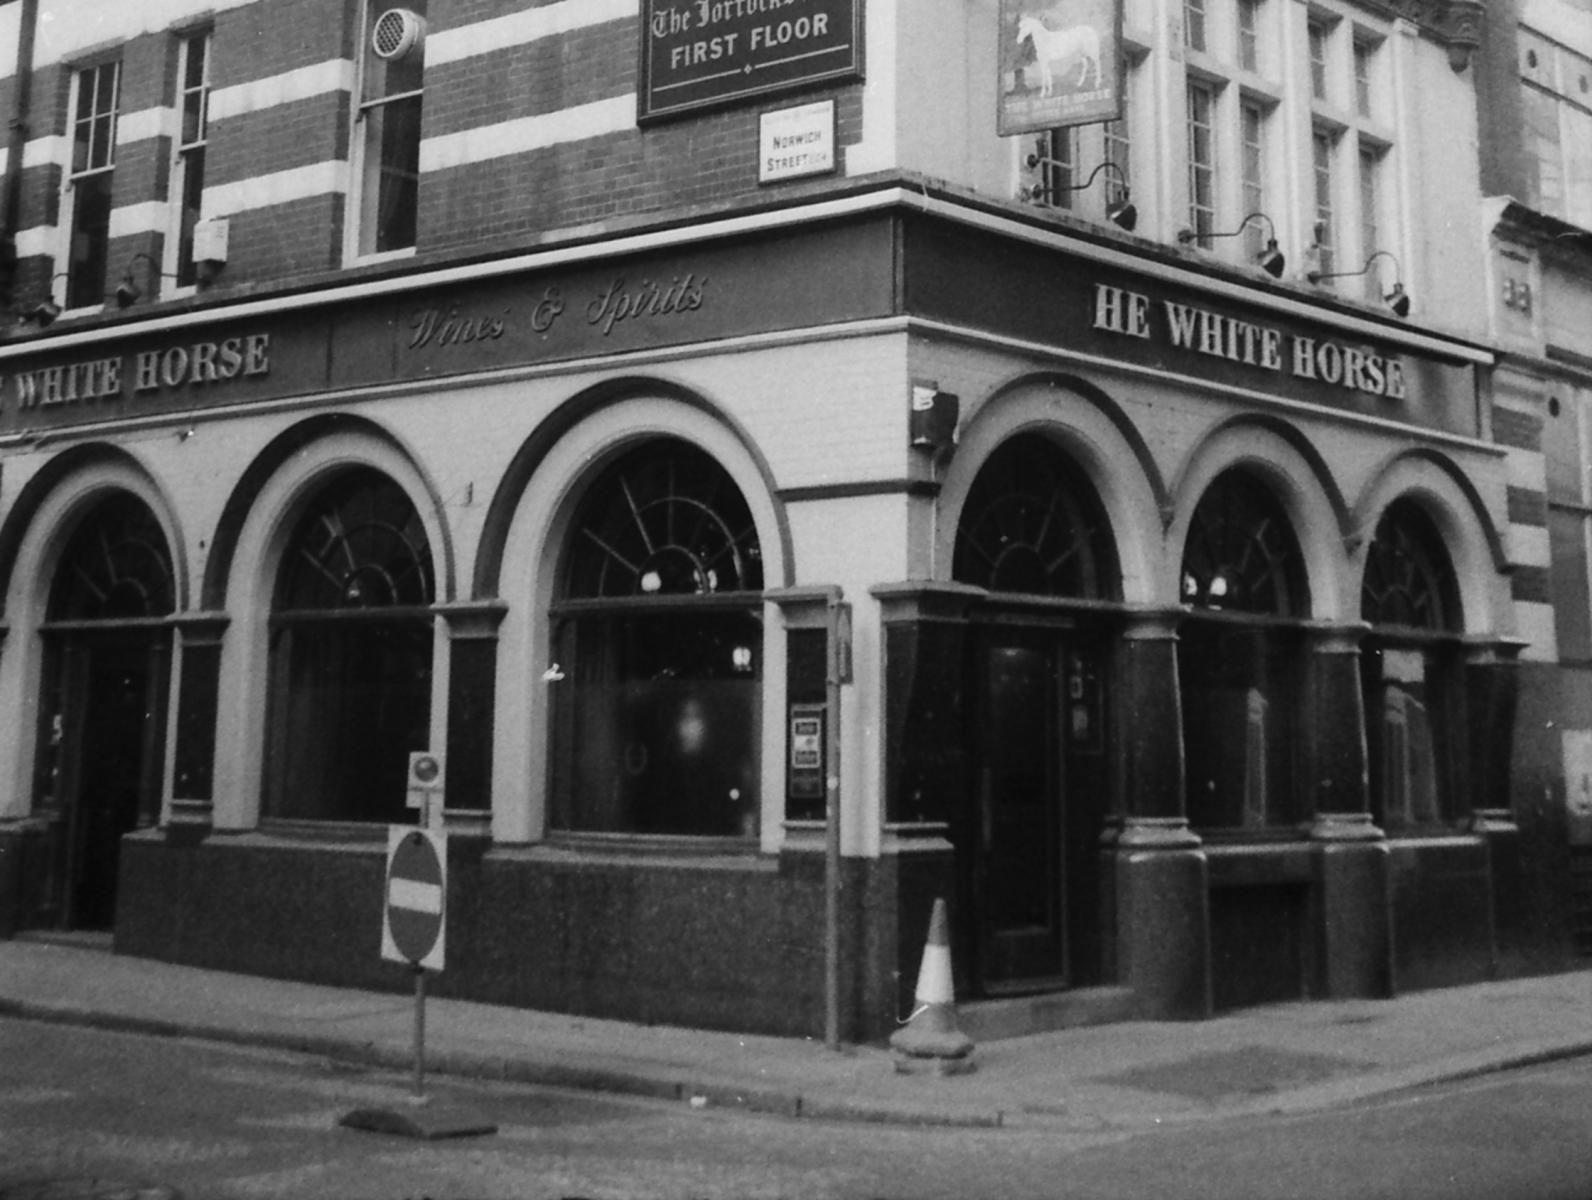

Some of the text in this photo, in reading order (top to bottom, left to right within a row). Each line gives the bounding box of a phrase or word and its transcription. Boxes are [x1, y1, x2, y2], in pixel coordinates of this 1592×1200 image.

[651, 8, 691, 39] The
[671, 13, 829, 70] FIRST FLOOR
[768, 154, 808, 172] STREET
[408, 273, 710, 349] Wines & Spirits
[1093, 283, 1405, 400] HE WHITE HORSE
[15, 356, 123, 408] WHITE
[134, 333, 270, 392] HORSE
